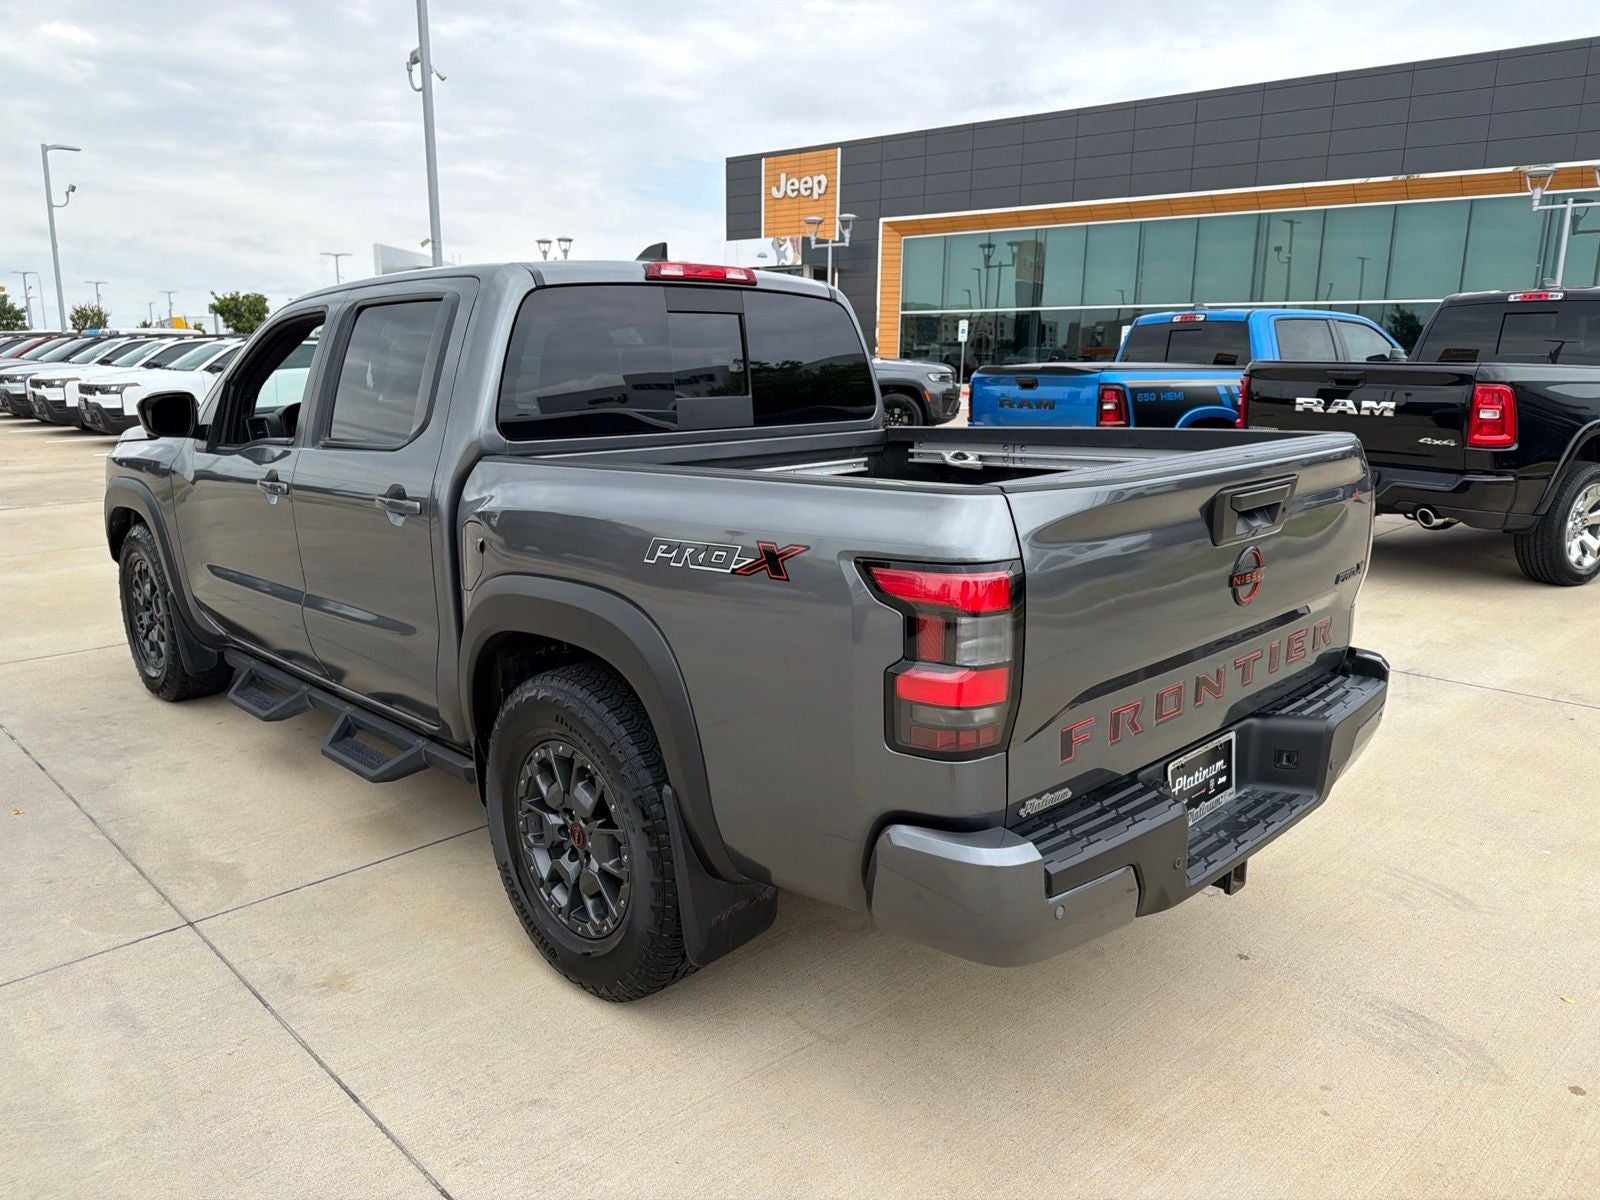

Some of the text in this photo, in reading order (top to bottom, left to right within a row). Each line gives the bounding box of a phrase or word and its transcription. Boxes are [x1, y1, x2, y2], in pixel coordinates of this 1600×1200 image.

[770, 172, 828, 200] Jeep
[997, 398, 1056, 411] RAM
[1160, 391, 1185, 401] HEMI
[1295, 397, 1396, 417] RAM
[1060, 616, 1333, 766] FRONTIER
[1172, 759, 1227, 796] Platinum
[1018, 787, 1072, 817] Platinum
